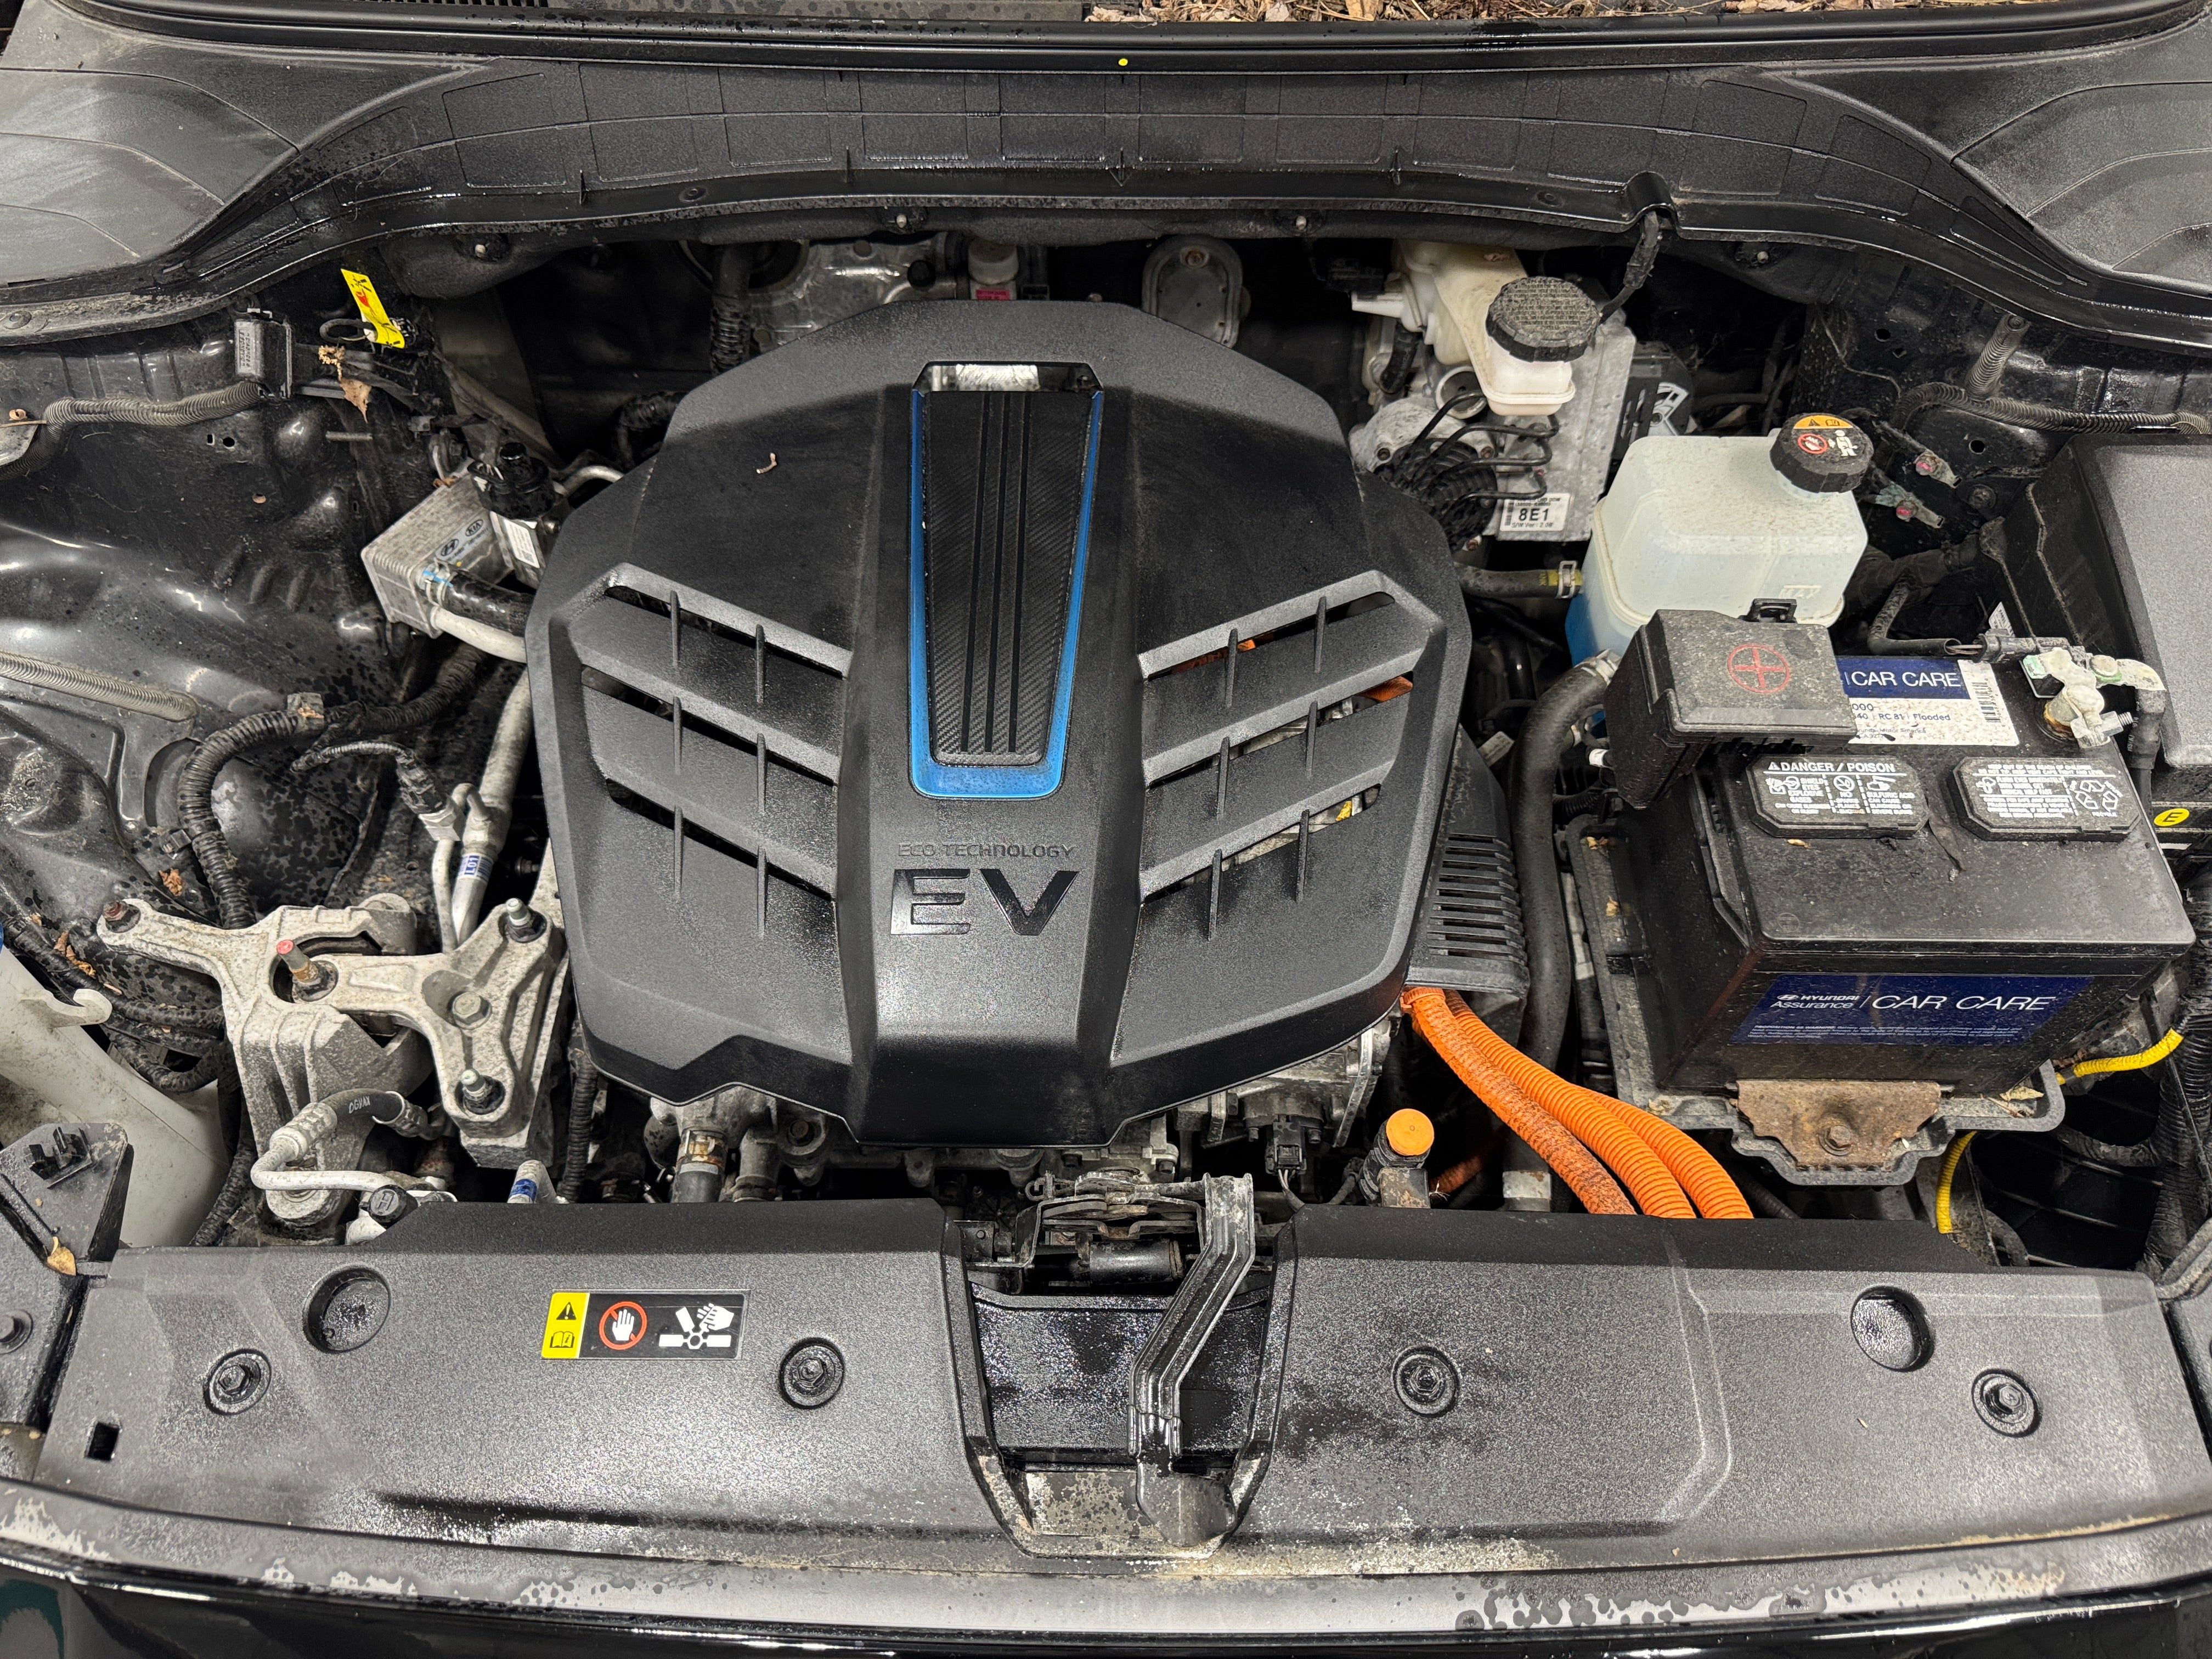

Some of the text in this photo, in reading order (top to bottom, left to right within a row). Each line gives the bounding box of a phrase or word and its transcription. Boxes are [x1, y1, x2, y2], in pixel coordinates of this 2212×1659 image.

[1518, 508, 1549, 521] 8E1
[468, 522, 481, 534] KIA
[1851, 671, 1961, 687] CAR CARE
[1781, 763, 1835, 771] DANGER
[1847, 763, 1896, 772] POISON
[2163, 812, 2183, 822] E
[890, 868, 1080, 936] EV
[1770, 1001, 1854, 1009] Assurance
[1872, 995, 2057, 1011] CAR CARE
